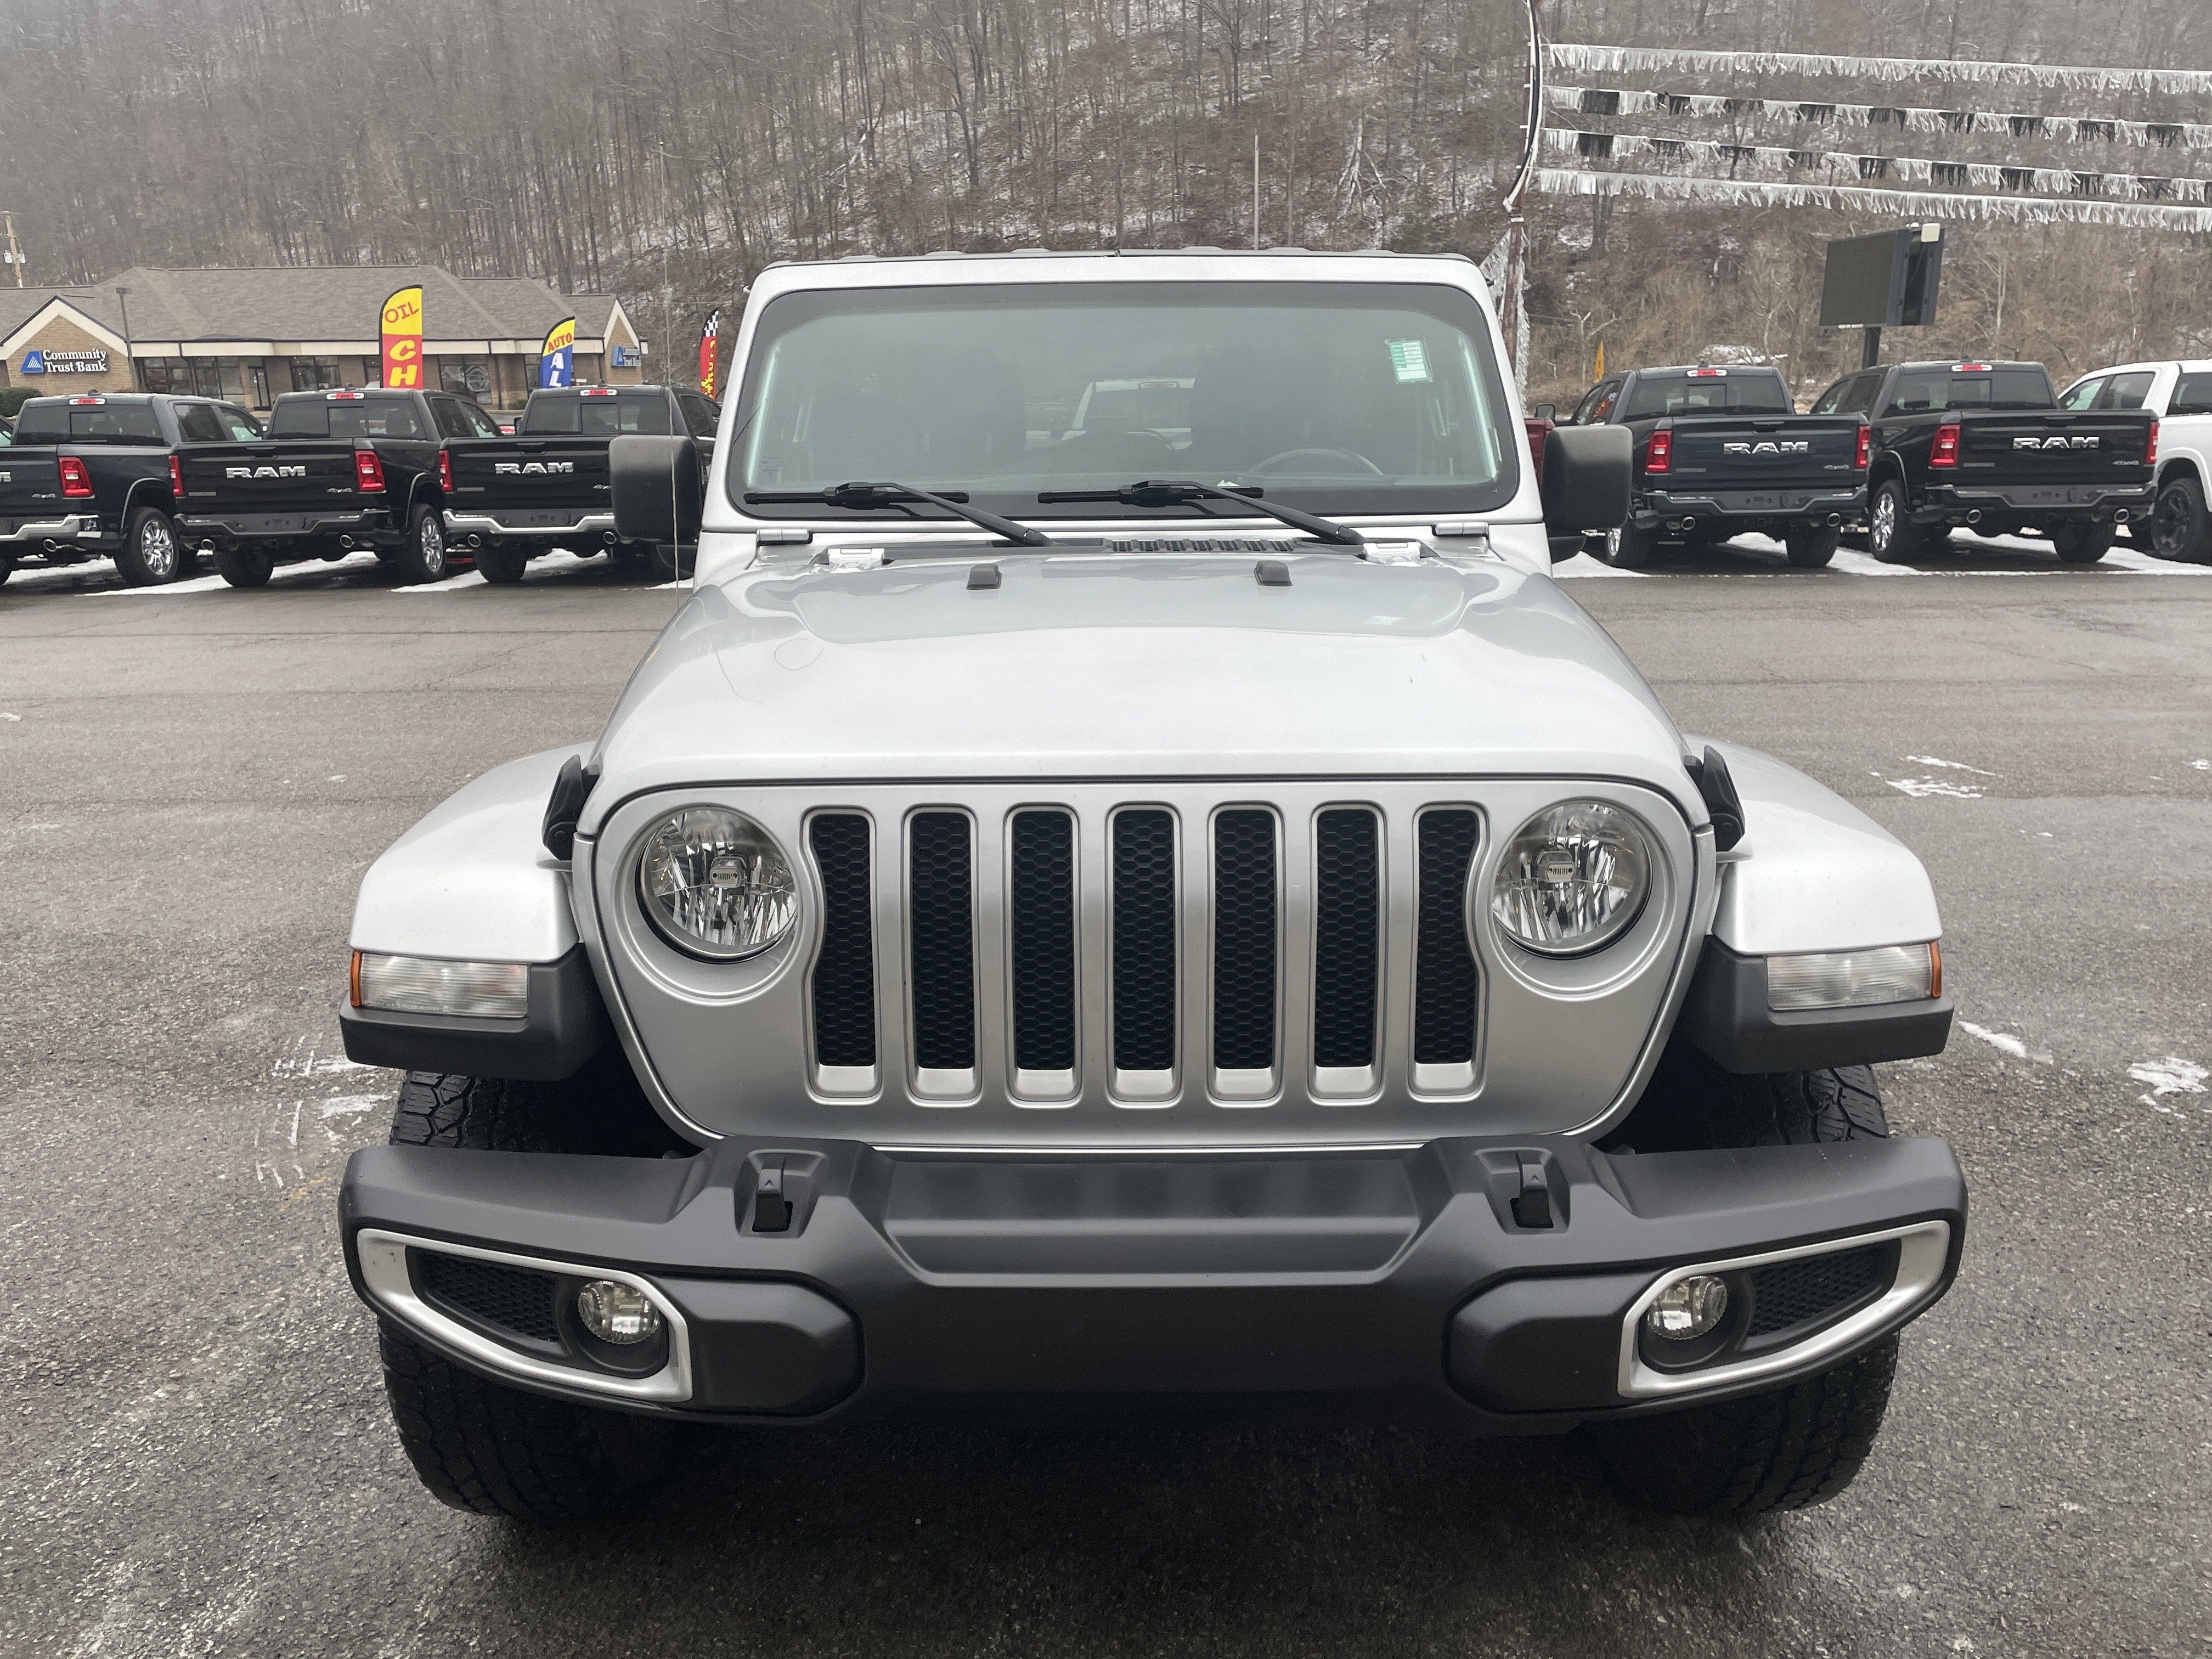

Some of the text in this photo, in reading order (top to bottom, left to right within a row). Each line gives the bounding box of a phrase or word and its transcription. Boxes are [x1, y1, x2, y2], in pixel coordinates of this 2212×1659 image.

[385, 302, 419, 323] OIL
[548, 332, 572, 353] AUTO
[42, 348, 107, 362] Community
[44, 360, 108, 373] Trust Bank
[1723, 441, 1809, 455] RAM
[2012, 436, 2100, 449] RAM
[225, 465, 306, 479] RAM
[495, 462, 574, 474] RAM
